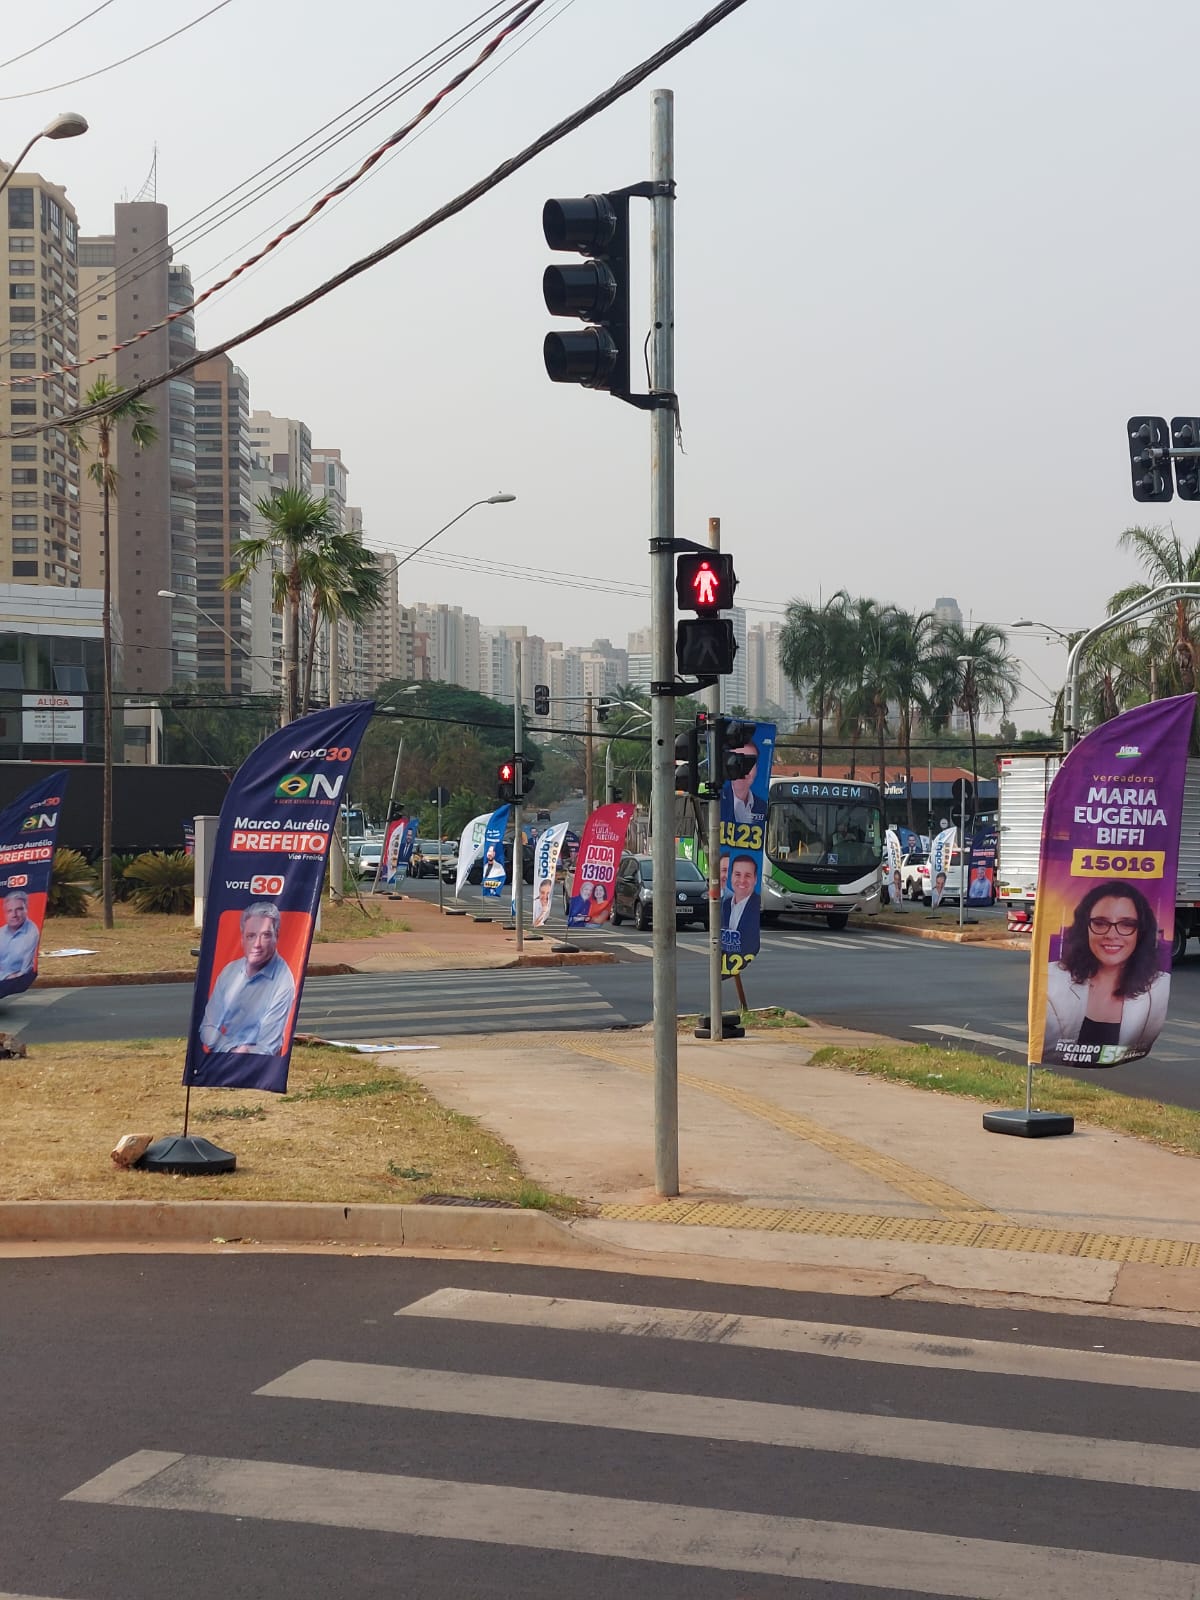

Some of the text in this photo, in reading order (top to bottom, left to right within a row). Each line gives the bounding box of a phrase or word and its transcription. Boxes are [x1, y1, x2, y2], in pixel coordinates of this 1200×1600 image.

[37, 698, 70, 706] ALUGA
[1093, 774, 1154, 783] vereadora
[791, 785, 861, 798] GARAGEM
[1087, 787, 1158, 806] MARIA
[1073, 805, 1168, 826] EUGÊNIA
[234, 816, 331, 832] Marco Aurélio
[232, 832, 325, 852] PREFEITO
[1096, 827, 1145, 846] BIFFI
[587, 847, 613, 862] DUDA
[1081, 855, 1156, 872] 15016
[583, 864, 613, 882] 13180
[225, 876, 283, 895] VOTE 30
[1055, 1043, 1100, 1054] RICARDO
[1063, 1053, 1092, 1063] SILVA
